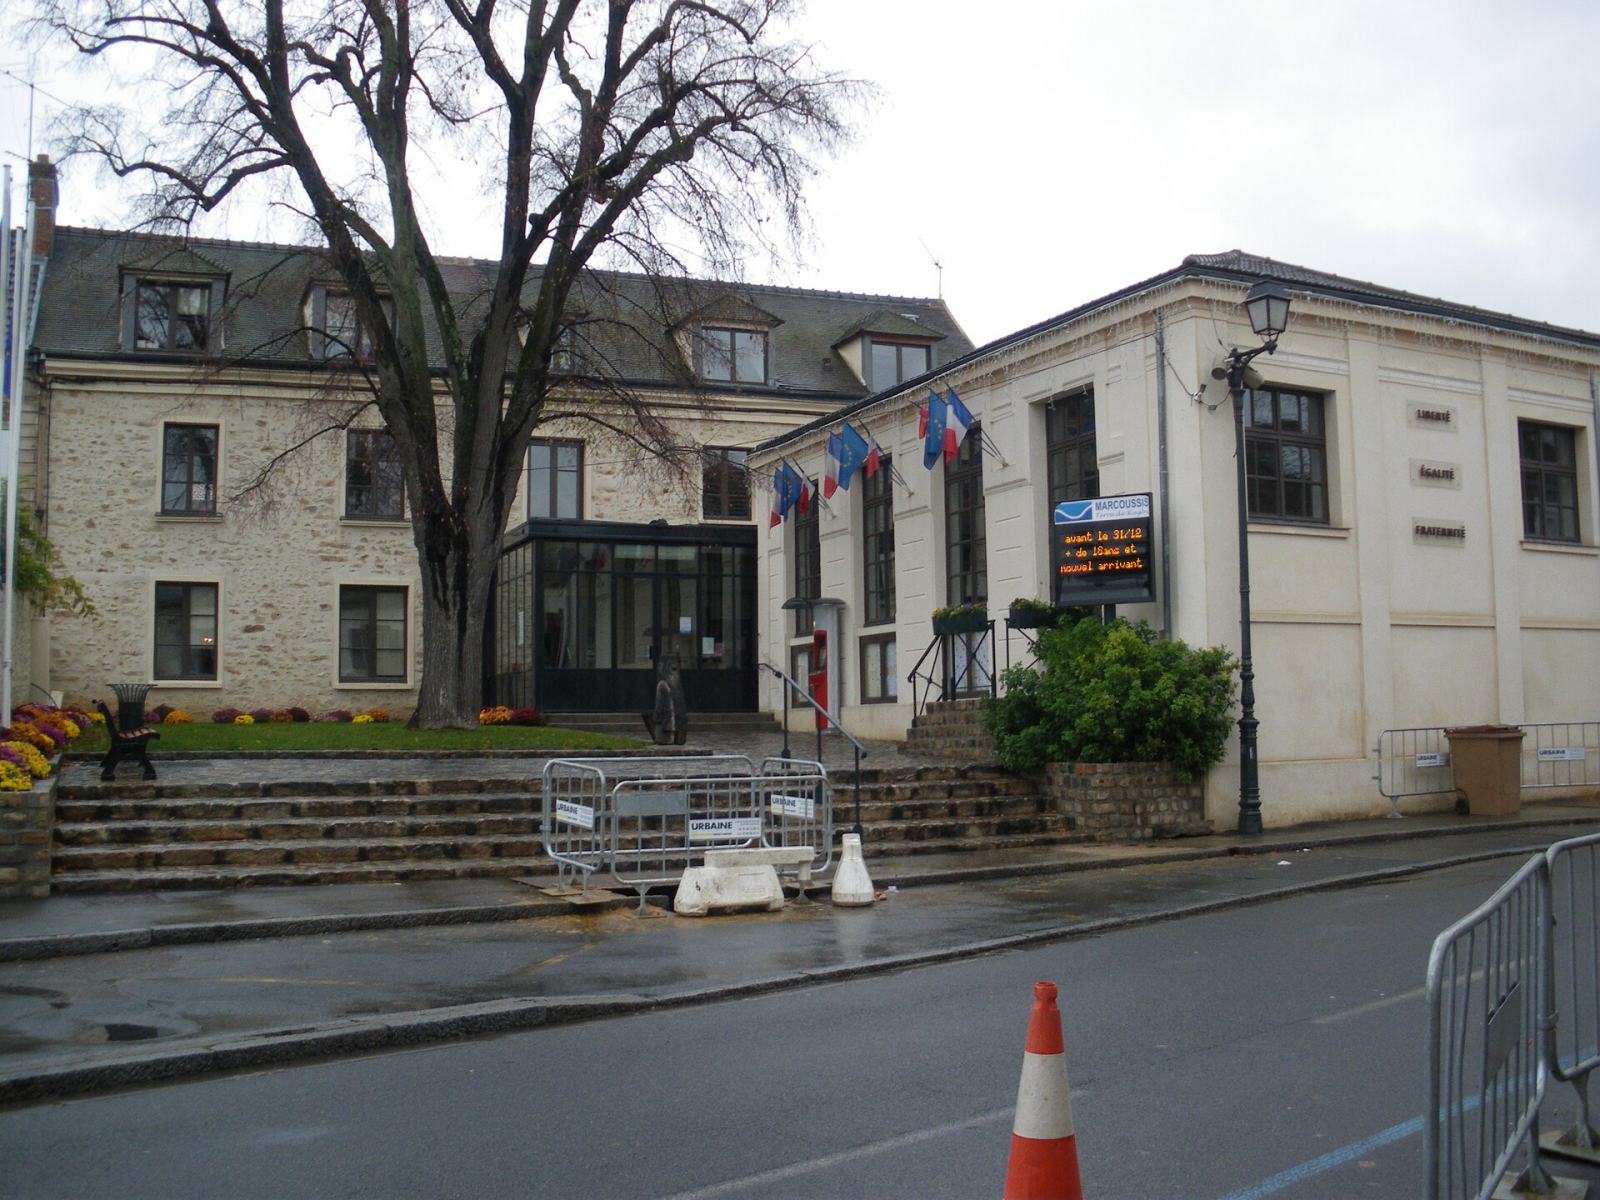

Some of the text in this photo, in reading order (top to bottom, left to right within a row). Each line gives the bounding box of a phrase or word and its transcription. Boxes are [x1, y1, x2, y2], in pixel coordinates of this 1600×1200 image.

[1417, 409, 1451, 422] LIBERTÉ
[1420, 464, 1455, 480] ÉGALITÉ
[1095, 498, 1149, 511] MARCOUSSIS
[1065, 528, 1142, 543] avant le 31/12
[1415, 525, 1466, 538] FRATERNITÉ
[1076, 547, 1088, 557] de
[1124, 543, 1137, 553] et
[1060, 557, 1143, 573] nouvel arrivant
[691, 822, 733, 831] URBAINE
